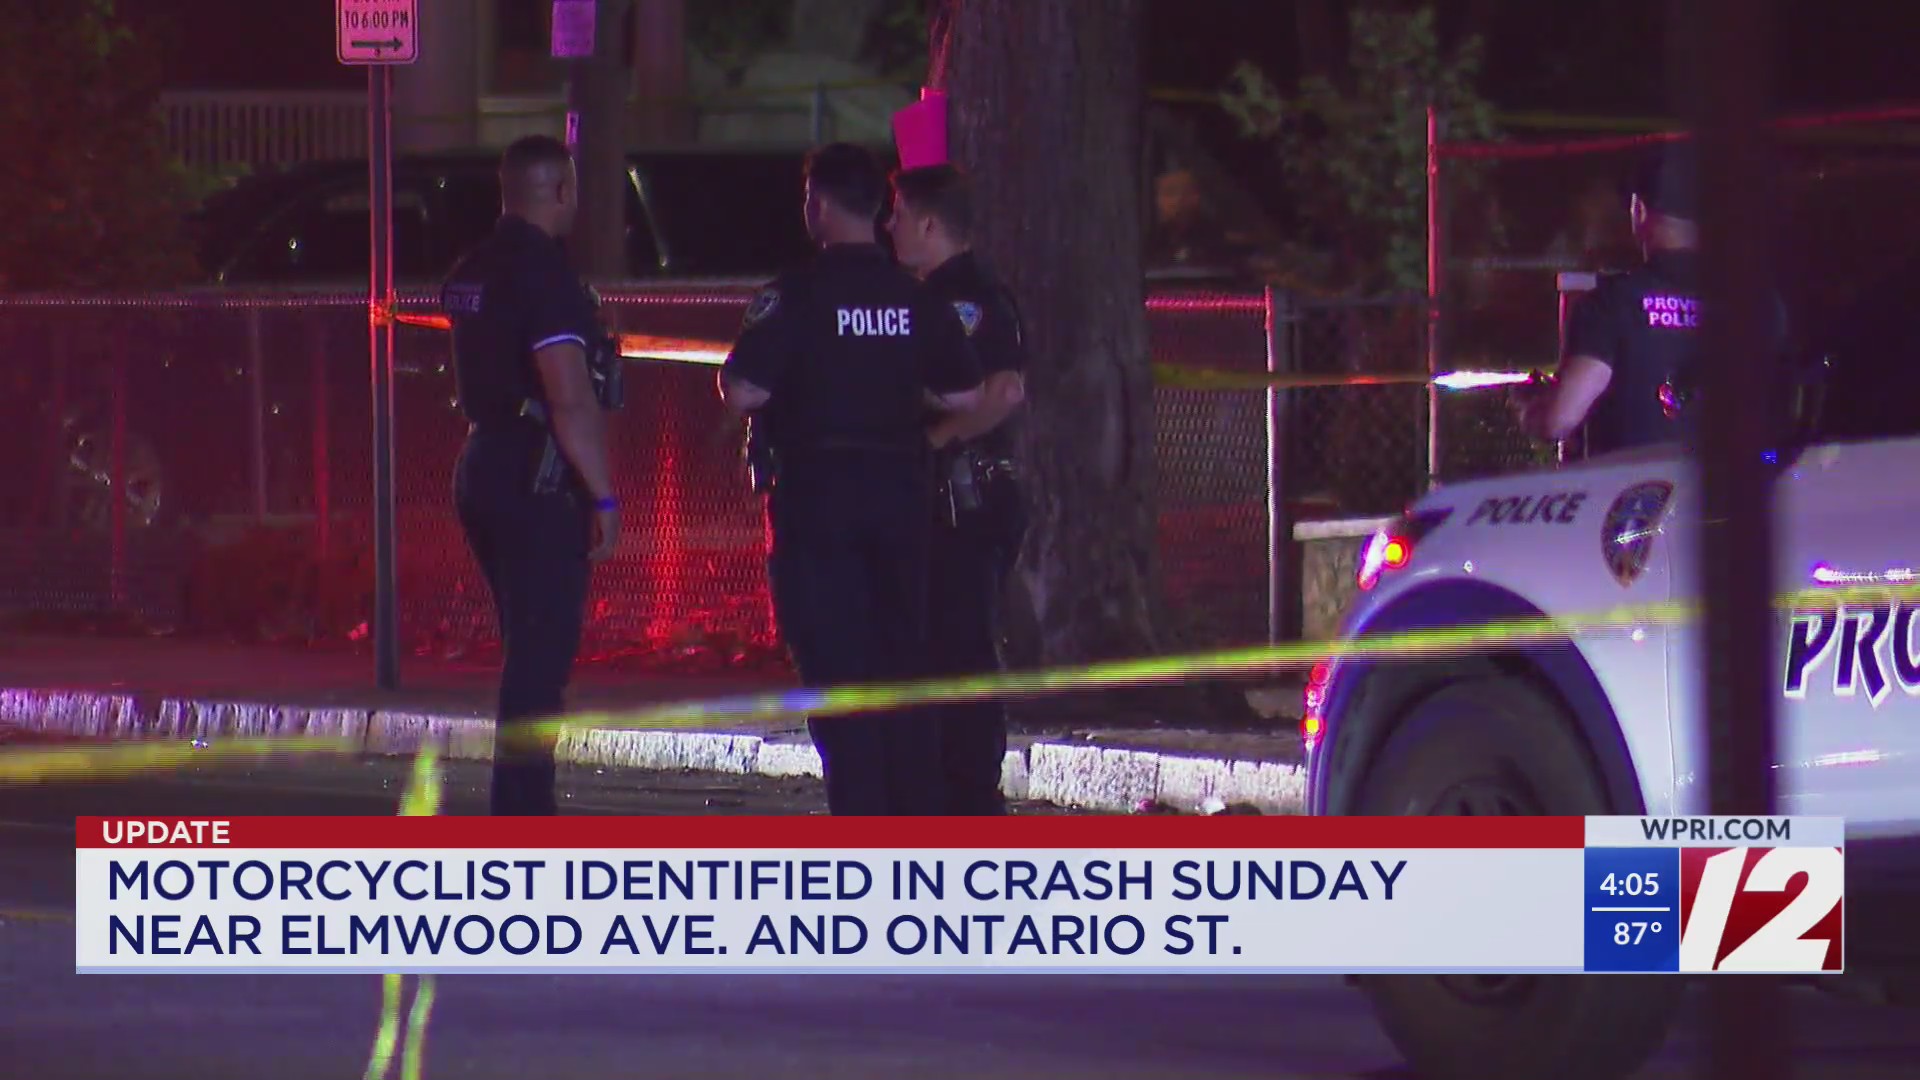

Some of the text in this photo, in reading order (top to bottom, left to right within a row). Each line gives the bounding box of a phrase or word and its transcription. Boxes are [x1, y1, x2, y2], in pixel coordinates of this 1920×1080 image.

[392, 10, 409, 29] PM
[836, 307, 911, 337] POLICE
[1465, 491, 1587, 527] POLICE
